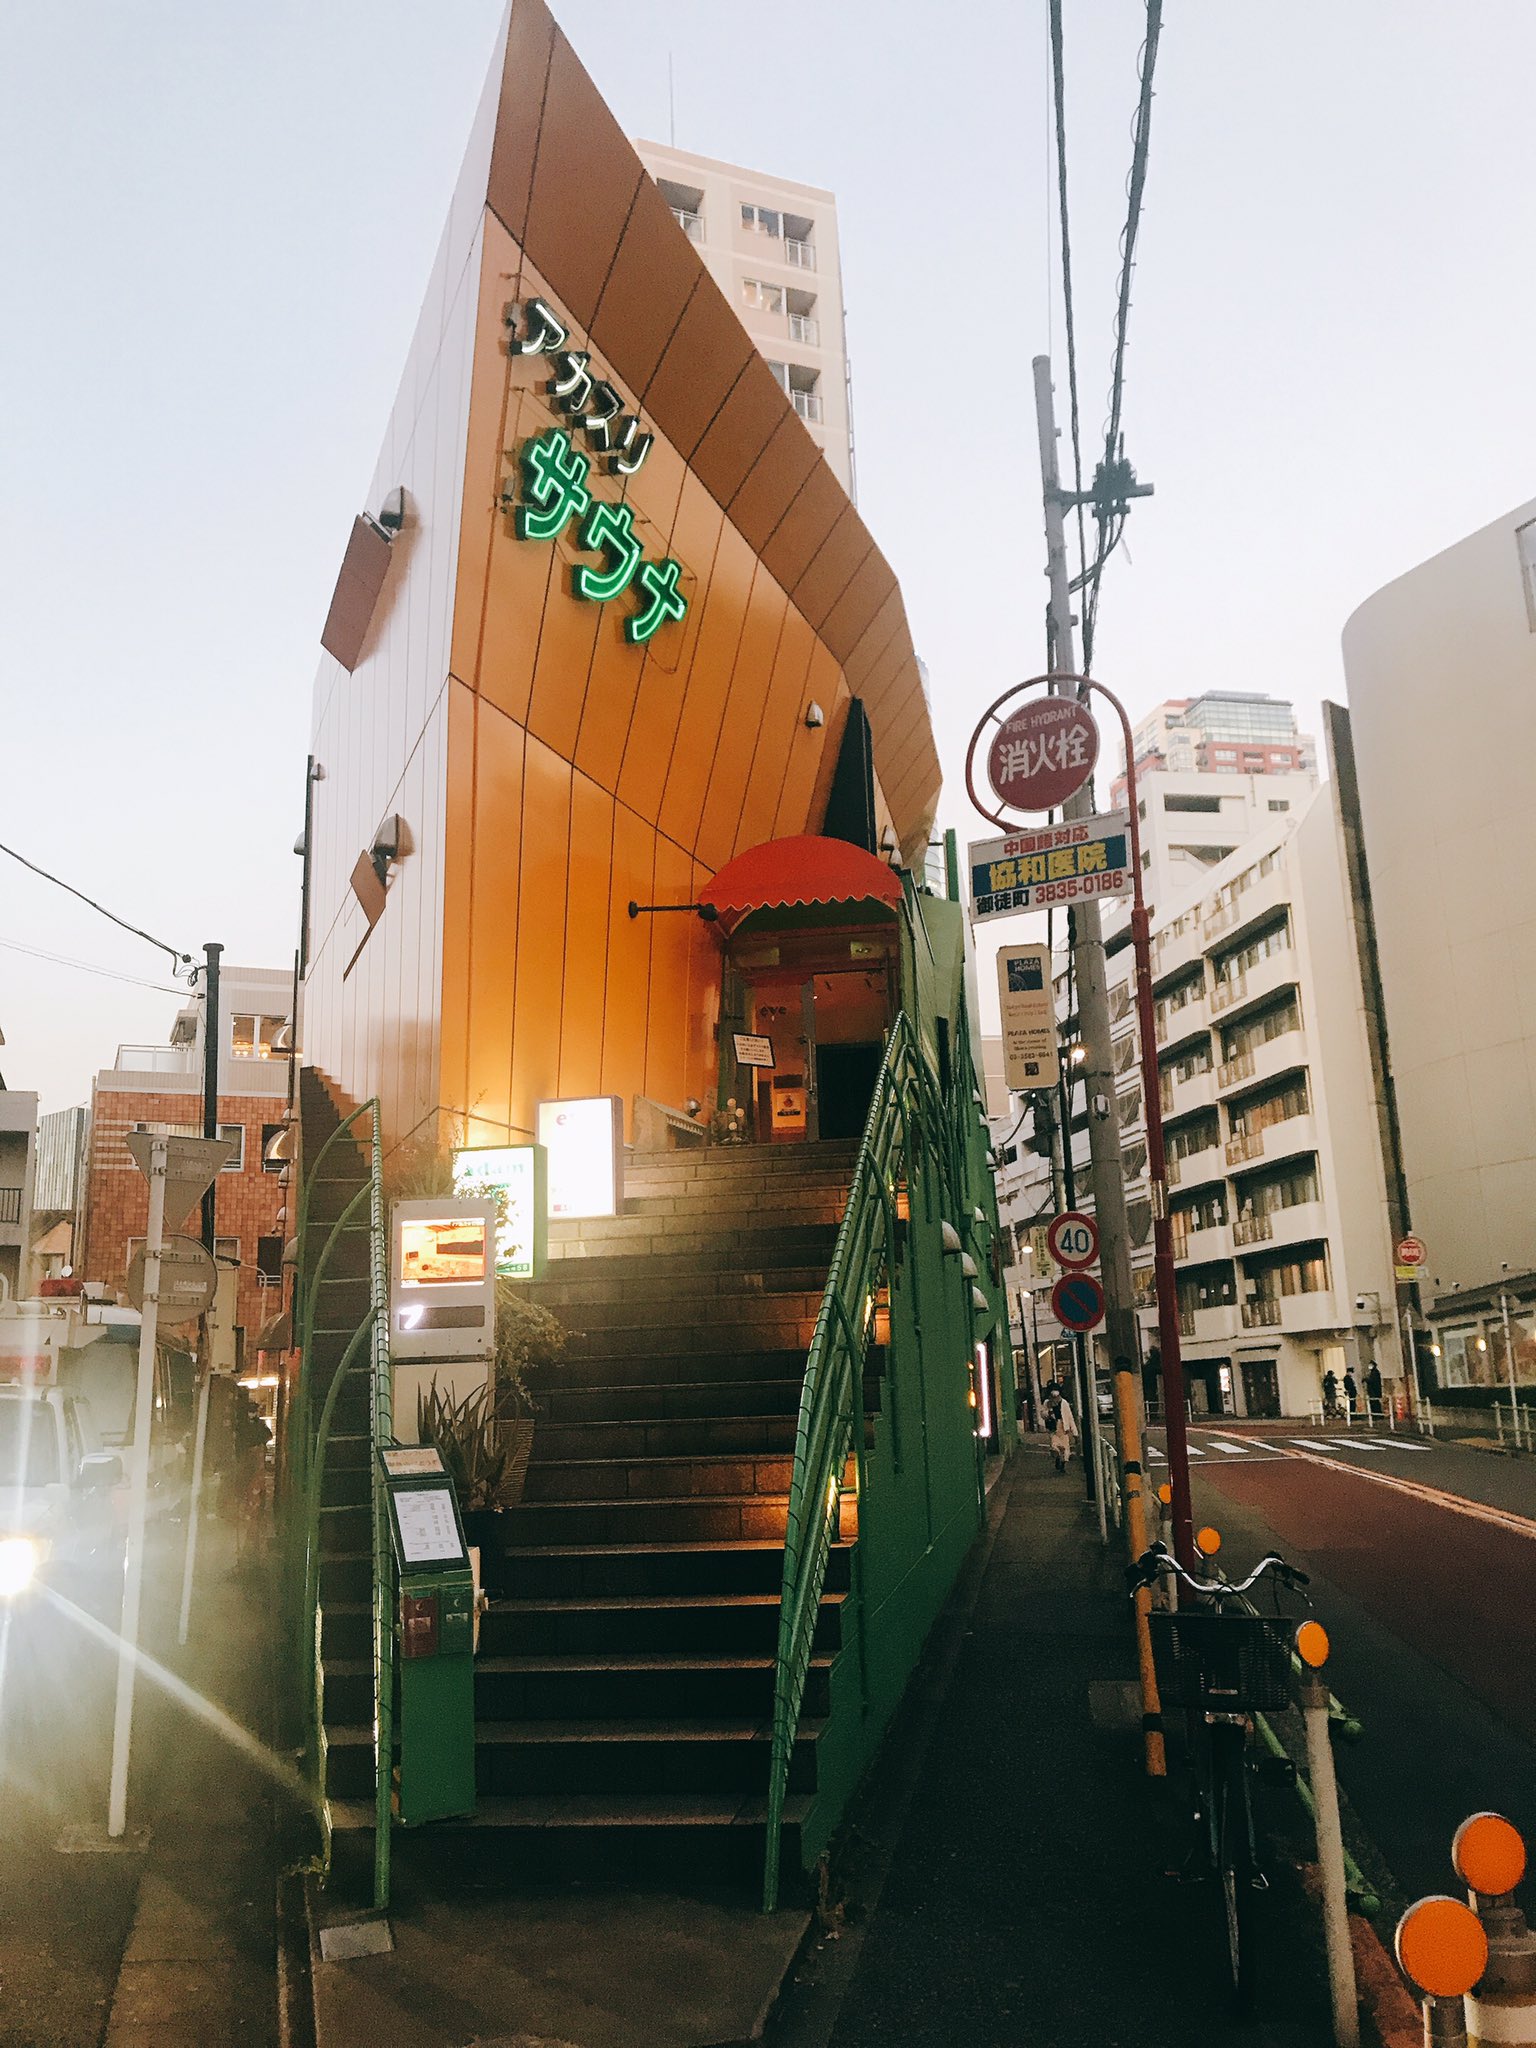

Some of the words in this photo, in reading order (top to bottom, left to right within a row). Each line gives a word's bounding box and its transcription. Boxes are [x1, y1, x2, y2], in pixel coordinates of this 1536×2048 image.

[513, 298, 654, 474] アカスリ
[514, 426, 688, 643] サウナ
[1006, 718, 1029, 734] FIRE
[1031, 705, 1077, 728] HYDRANT
[999, 723, 1090, 785] 消火栓
[990, 843, 1107, 892] 協和医院
[976, 889, 1030, 915] 御徒町
[1035, 870, 1123, 904] 3835-0186
[1060, 1228, 1089, 1253] 40
